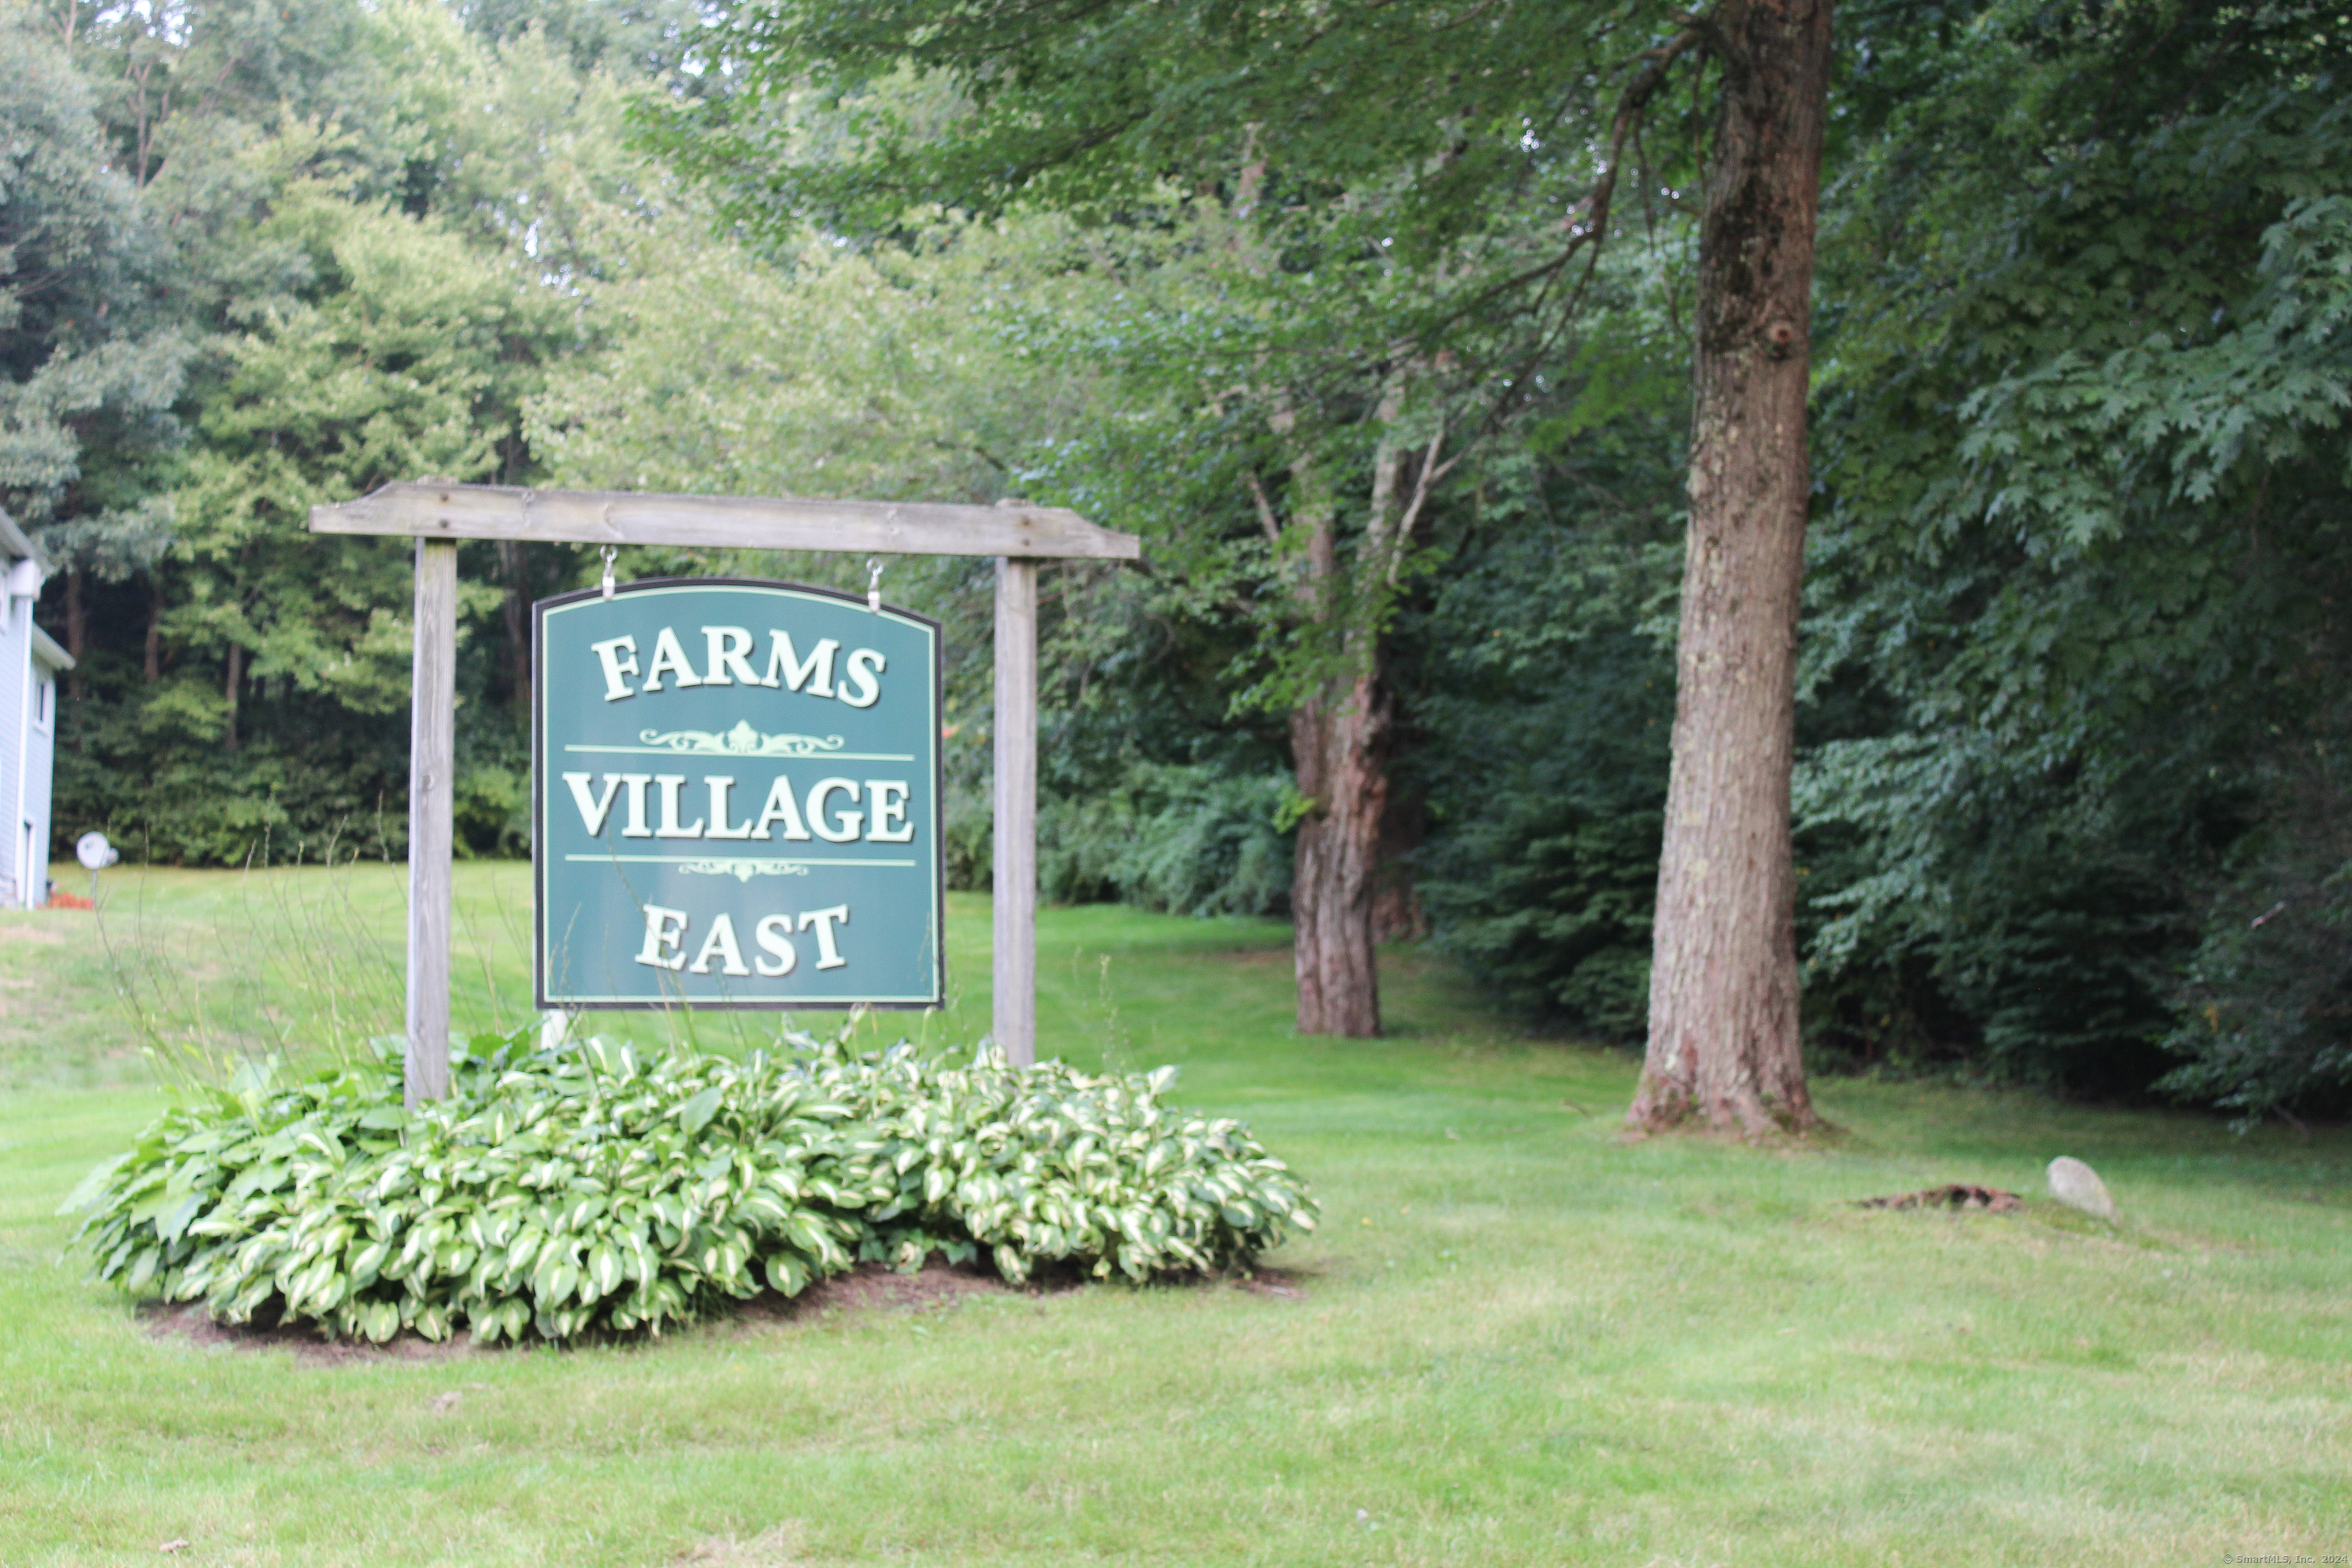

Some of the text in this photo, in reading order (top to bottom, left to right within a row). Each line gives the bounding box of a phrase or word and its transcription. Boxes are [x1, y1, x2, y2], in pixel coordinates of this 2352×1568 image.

[591, 626, 887, 708] FARMS
[562, 772, 915, 844] VILLAGE
[635, 903, 849, 977] EAST
